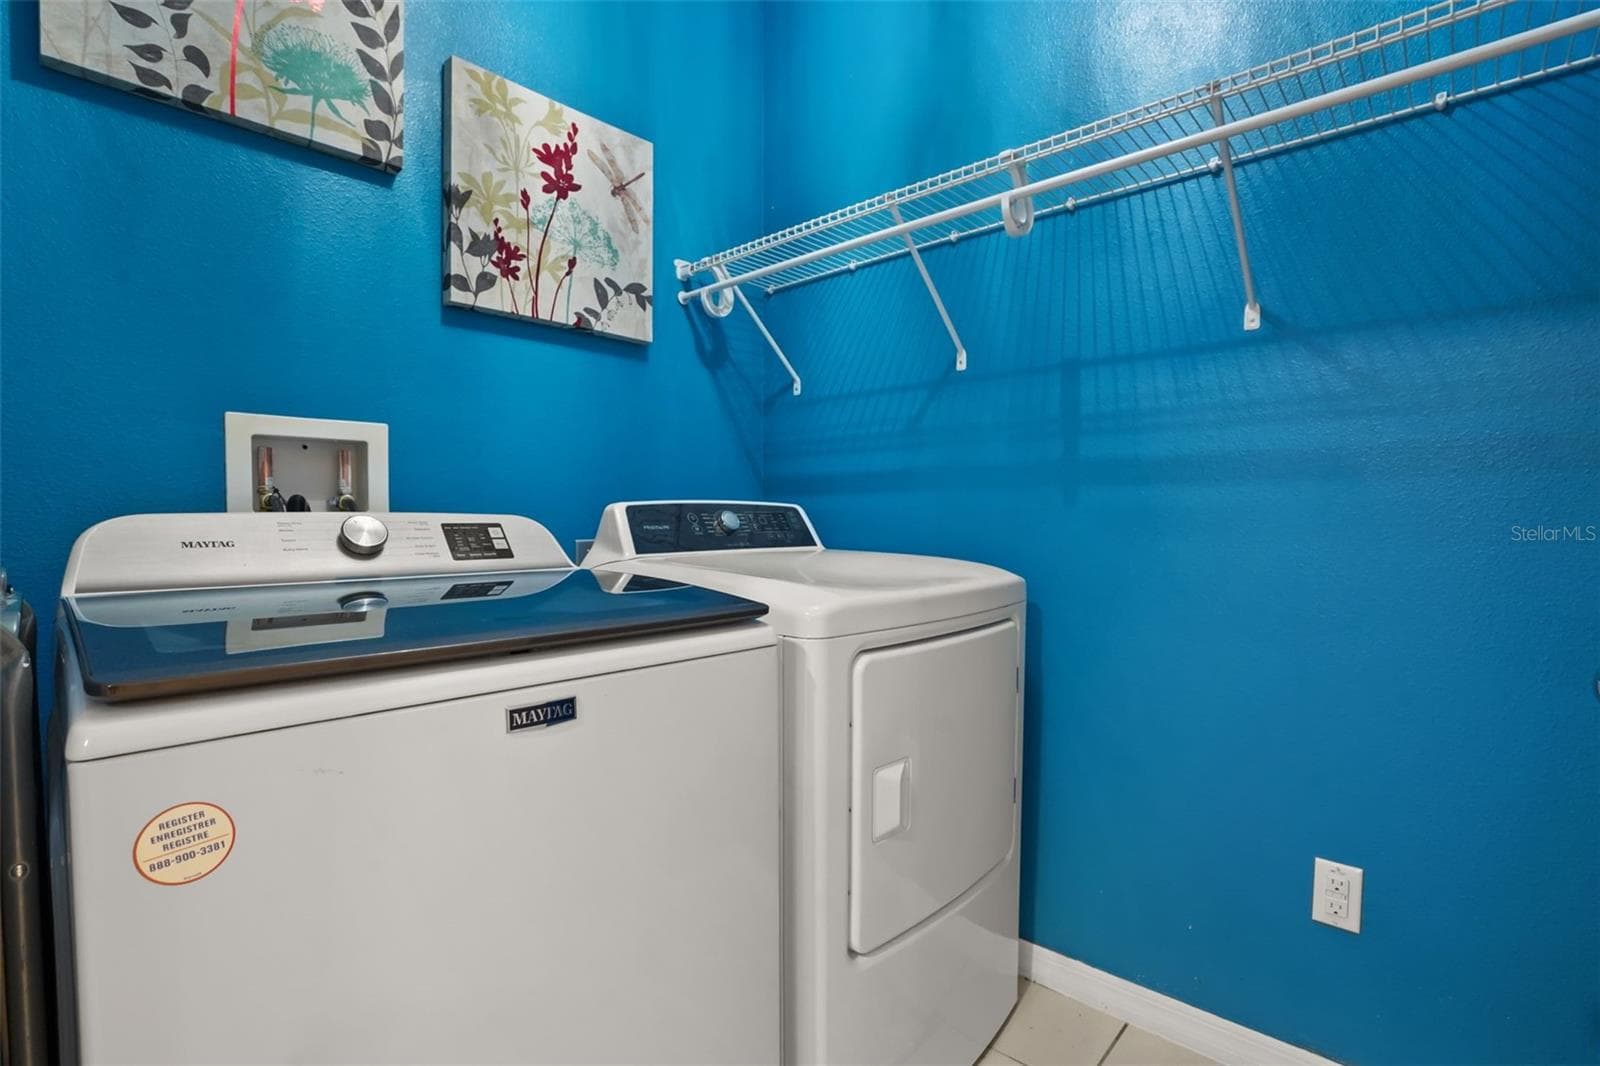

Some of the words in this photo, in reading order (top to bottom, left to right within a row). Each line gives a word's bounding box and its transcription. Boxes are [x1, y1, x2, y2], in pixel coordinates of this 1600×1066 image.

[181, 540, 235, 549] MAYTAG
[512, 703, 572, 726] MAYTAG
[150, 818, 216, 844] ENREGISTRER
[158, 810, 205, 831] REGISTER
[149, 840, 226, 872] 888-900-3381
